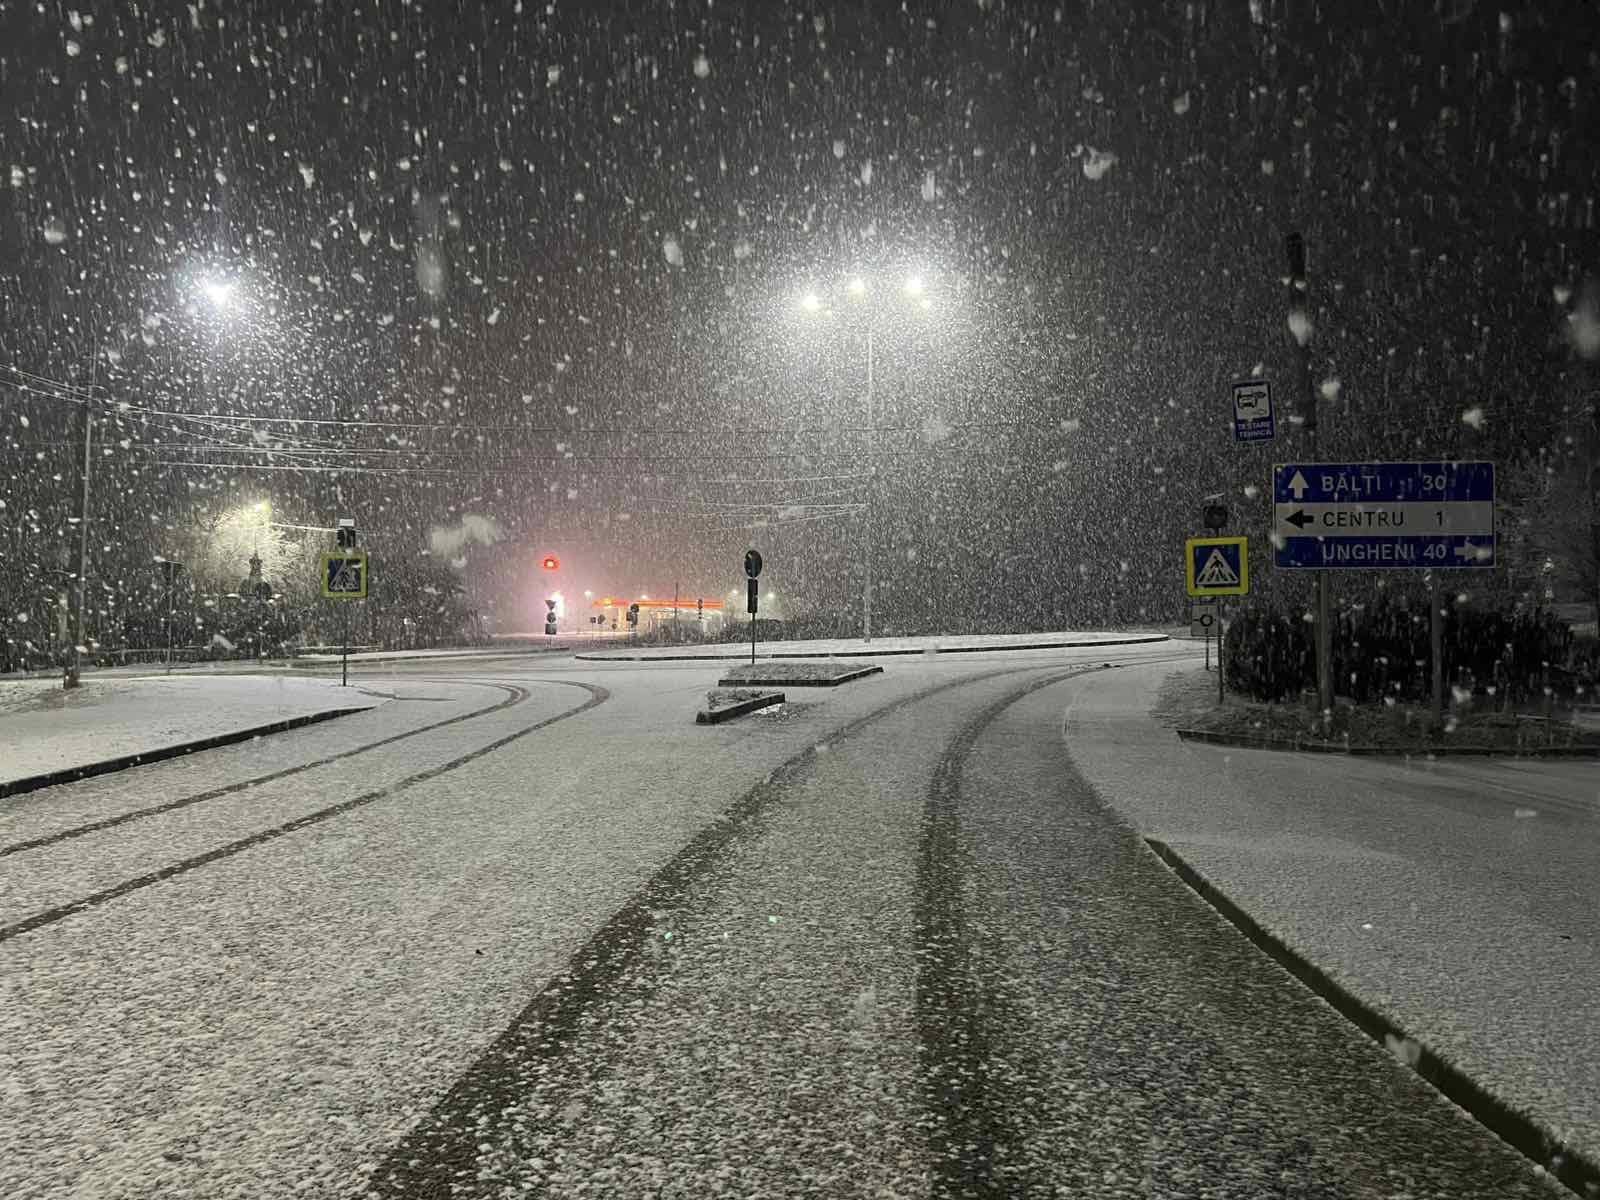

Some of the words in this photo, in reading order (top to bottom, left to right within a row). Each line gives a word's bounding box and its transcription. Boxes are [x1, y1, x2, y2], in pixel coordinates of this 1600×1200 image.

[1423, 473, 1447, 491] 30
[1322, 511, 1404, 528] CENTRU
[1436, 511, 1444, 528] 1
[1322, 543, 1415, 561] UNGHENI
[1423, 543, 1447, 560] 40
